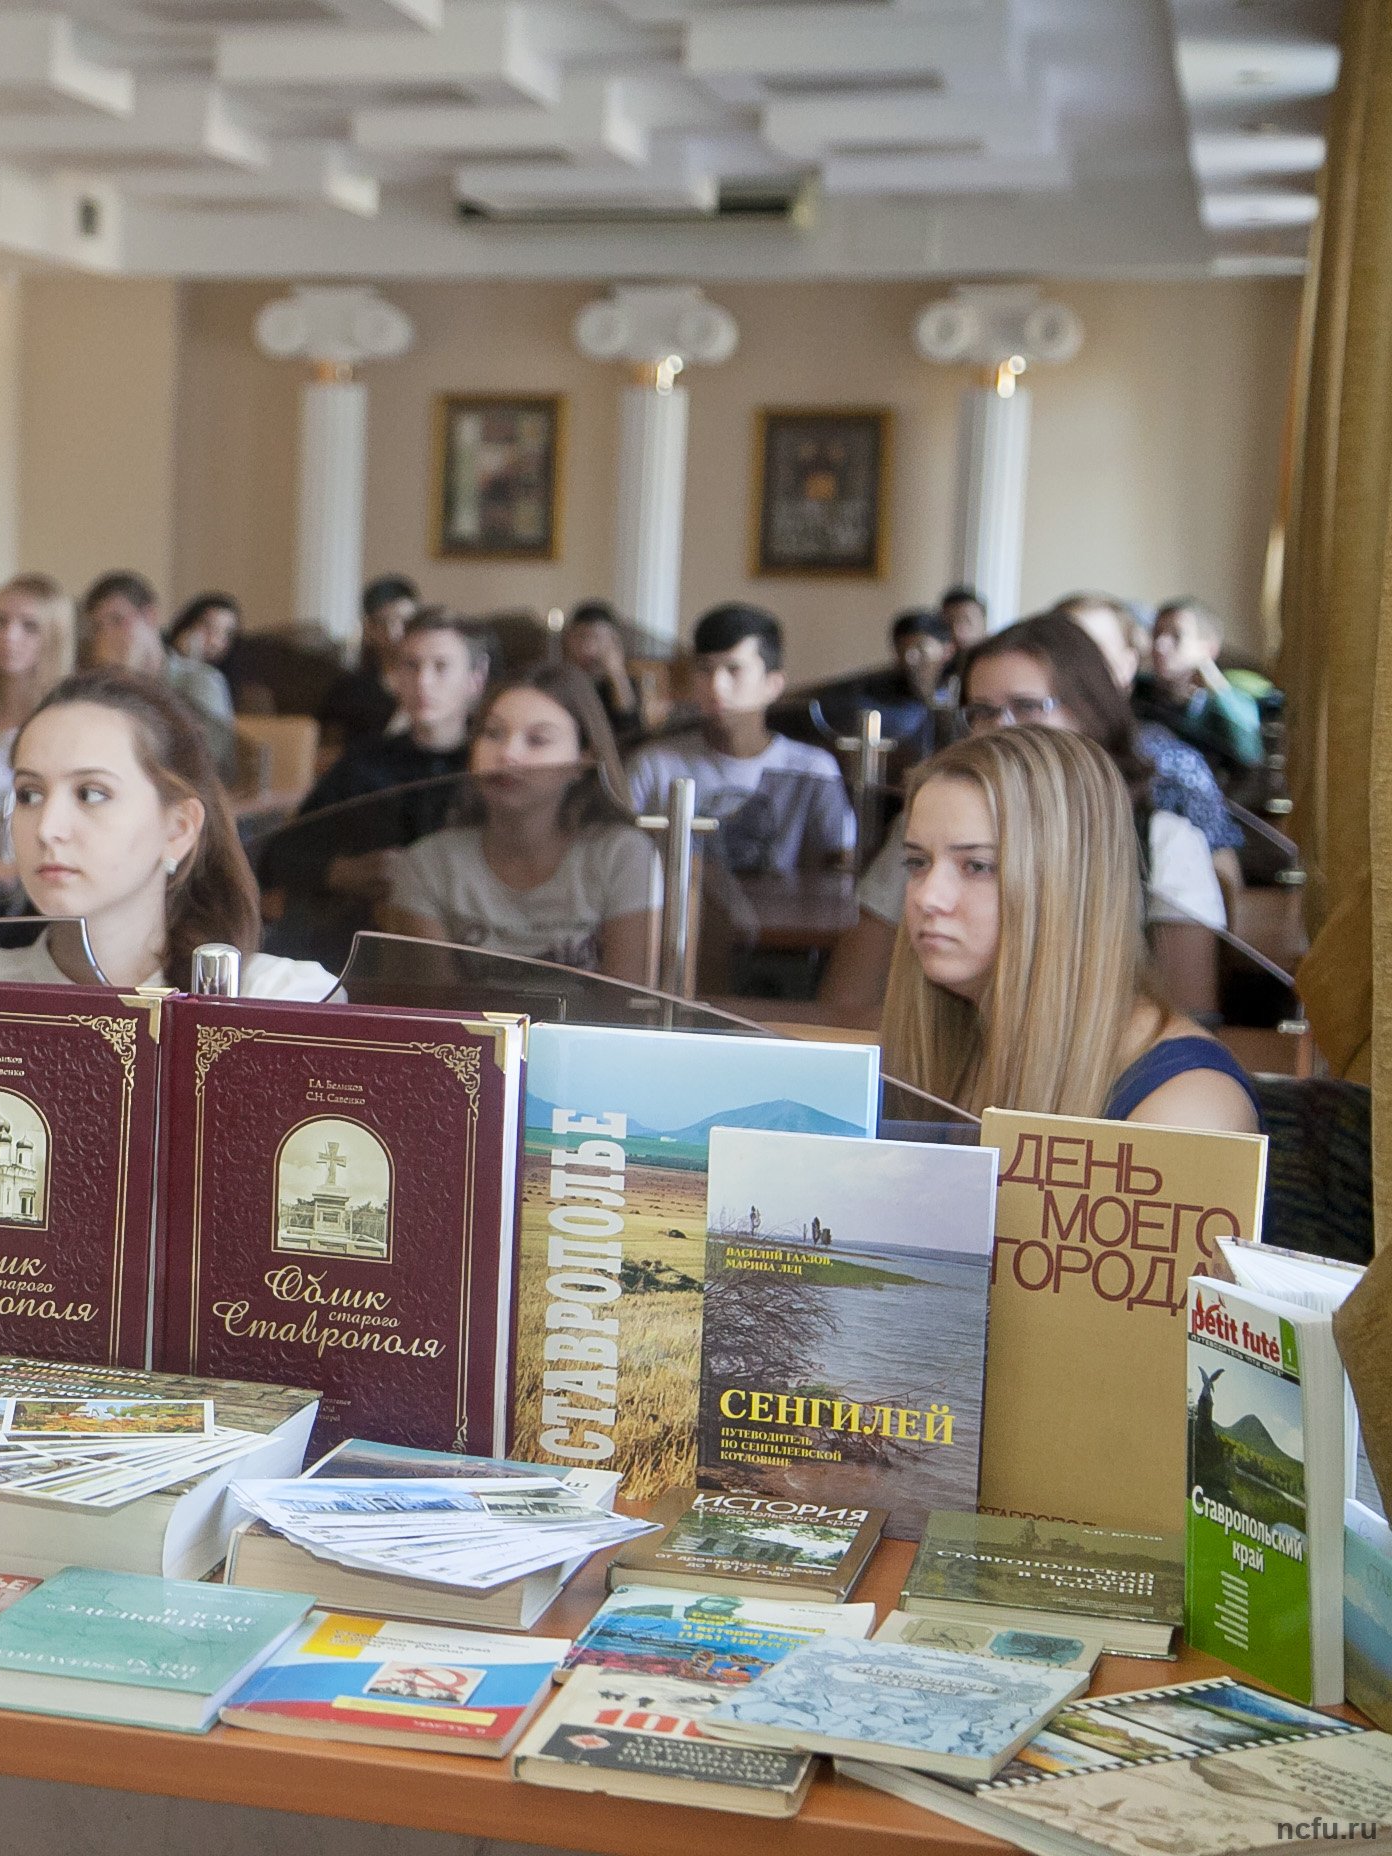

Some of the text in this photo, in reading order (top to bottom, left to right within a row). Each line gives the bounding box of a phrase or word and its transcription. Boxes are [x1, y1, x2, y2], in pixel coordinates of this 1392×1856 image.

[325, 1079, 363, 1092] Беликов
[328, 1093, 365, 1105] Савенко
[997, 1132, 1163, 1196] ДЕНЬ
[1041, 1189, 1241, 1260] МОЕГО
[725, 1258, 802, 1276] МАРИНА ЛЕЦ
[726, 1246, 834, 1268] ВАСИЛИЙ ГЛАЗОВ,
[264, 1265, 391, 1310] Облик
[539, 1108, 627, 1461] СТАВРОПОЛЬЕ
[213, 1300, 446, 1358] Ставрополя
[328, 1308, 400, 1328] старого
[1192, 1300, 1280, 1363] petit futé
[1191, 1334, 1244, 1360] ПУТЕВОДИТЕЛЬ
[10, 1358, 150, 1379] Ставрополь
[720, 1389, 956, 1446] СЕНГИЛЕЙ
[721, 1427, 813, 1447] ПУТЕВОДИТЕЛЬ
[720, 1449, 792, 1468] КОТЛОВИНЕ
[721, 1437, 843, 1463] ПО СЕНГИЛЕЕВСКОЙ
[691, 1504, 861, 1527] Ставропольского края
[694, 1493, 869, 1523] ИСТОРИЯ
[1192, 1485, 1303, 1562] Ставропольский
[677, 1555, 768, 1570] древнейших
[775, 1565, 832, 1577] времен
[937, 1550, 1155, 1580] СТАВРОПОЛЬСКИЙ
[1233, 1540, 1265, 1573] край
[715, 1563, 752, 1574] 1917
[757, 1569, 791, 1579] года
[1018, 1570, 1154, 1591] В ИСТОРИИ
[1095, 1573, 1154, 1585] КРАЙ
[1055, 1580, 1153, 1596] РОССИИ
